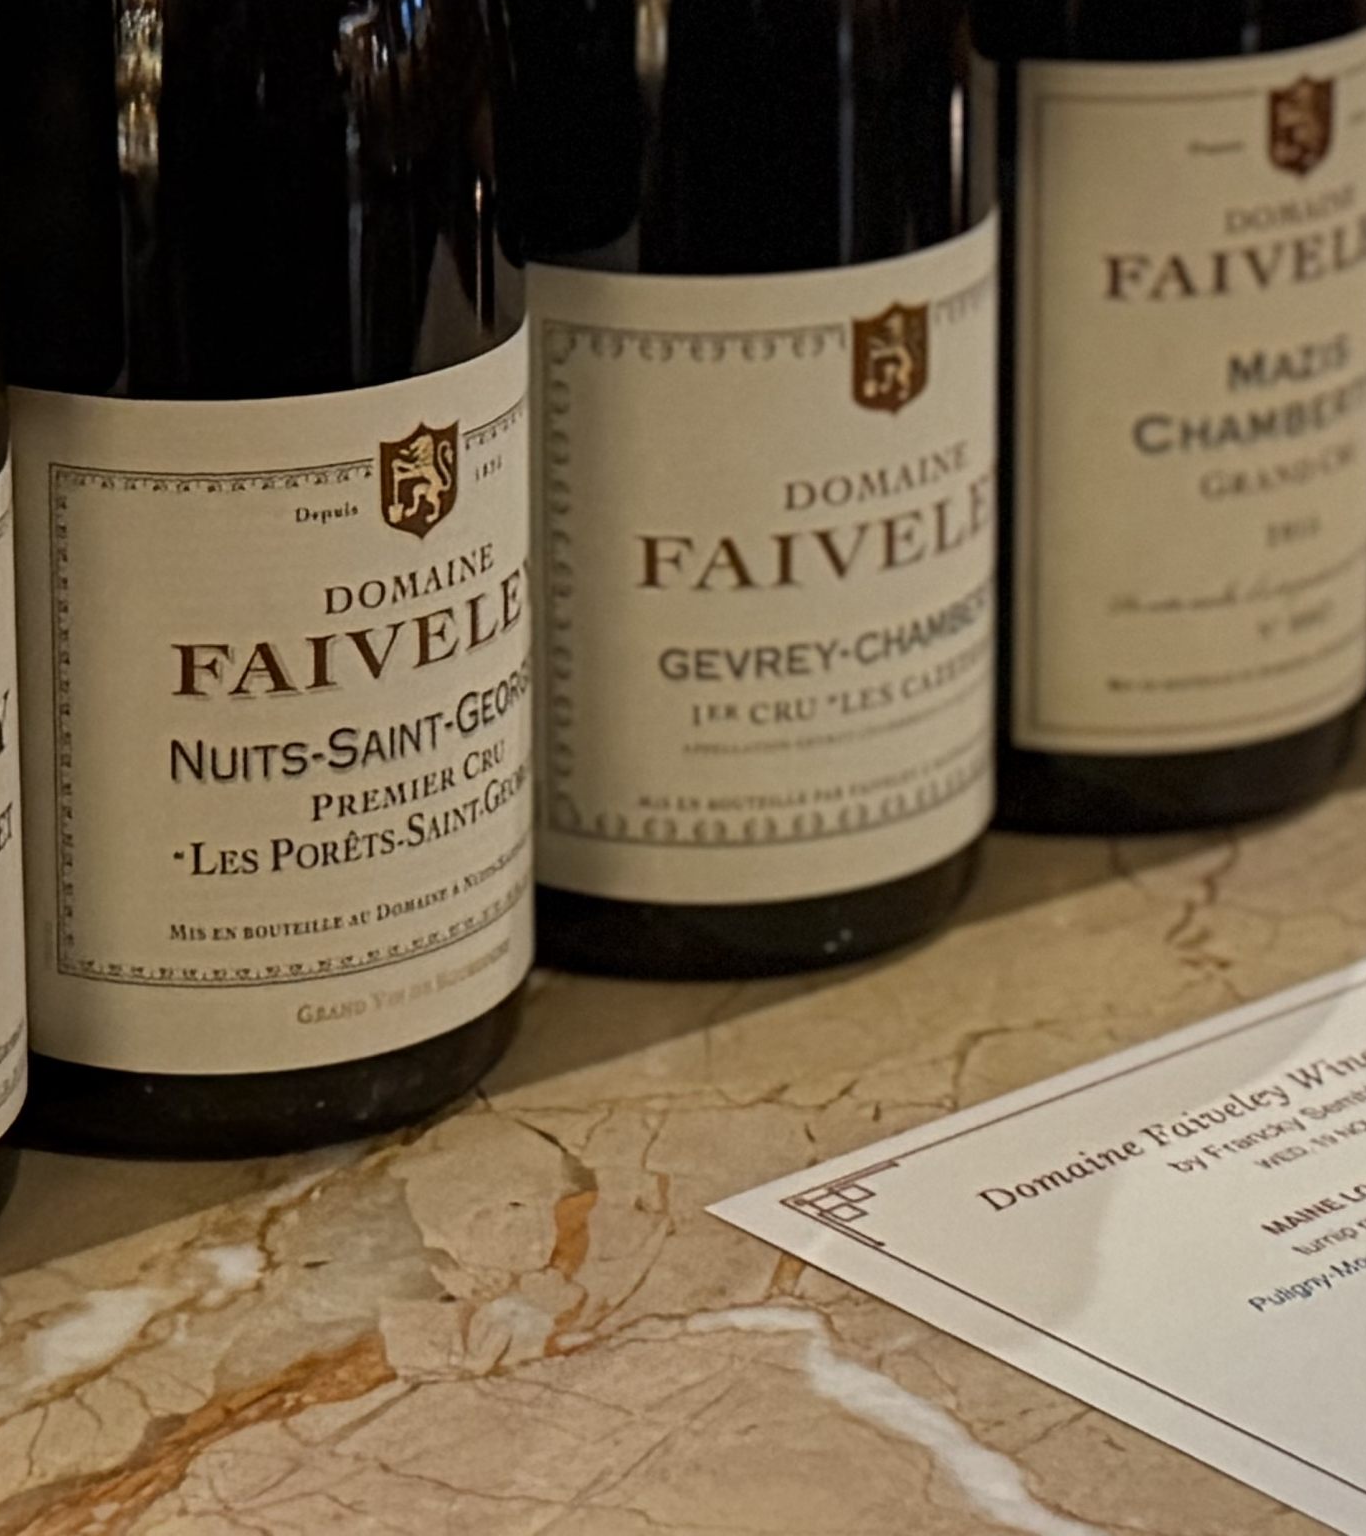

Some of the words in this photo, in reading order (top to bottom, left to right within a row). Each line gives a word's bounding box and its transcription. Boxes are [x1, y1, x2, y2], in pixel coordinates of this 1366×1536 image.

[783, 441, 969, 512] DOMAINE
[294, 501, 359, 525] Depuis
[323, 542, 495, 615] DOMAINE
[169, 560, 531, 697] FAIVELE
[749, 697, 818, 726] CRU
[311, 766, 456, 822] PREMIER
[463, 739, 506, 781] CRU
[170, 923, 207, 941] MIS
[212, 925, 237, 941] EN
[243, 917, 343, 941] BOUTEILLE
[348, 910, 372, 927] AU
[376, 887, 449, 923] DOMAINE
[977, 1138, 1141, 1212] Domaine
[1140, 1081, 1291, 1147] Faiveley
[1167, 1151, 1208, 1173] by
[1203, 1117, 1306, 1160] Francky
[1260, 1197, 1347, 1237] MAINE
